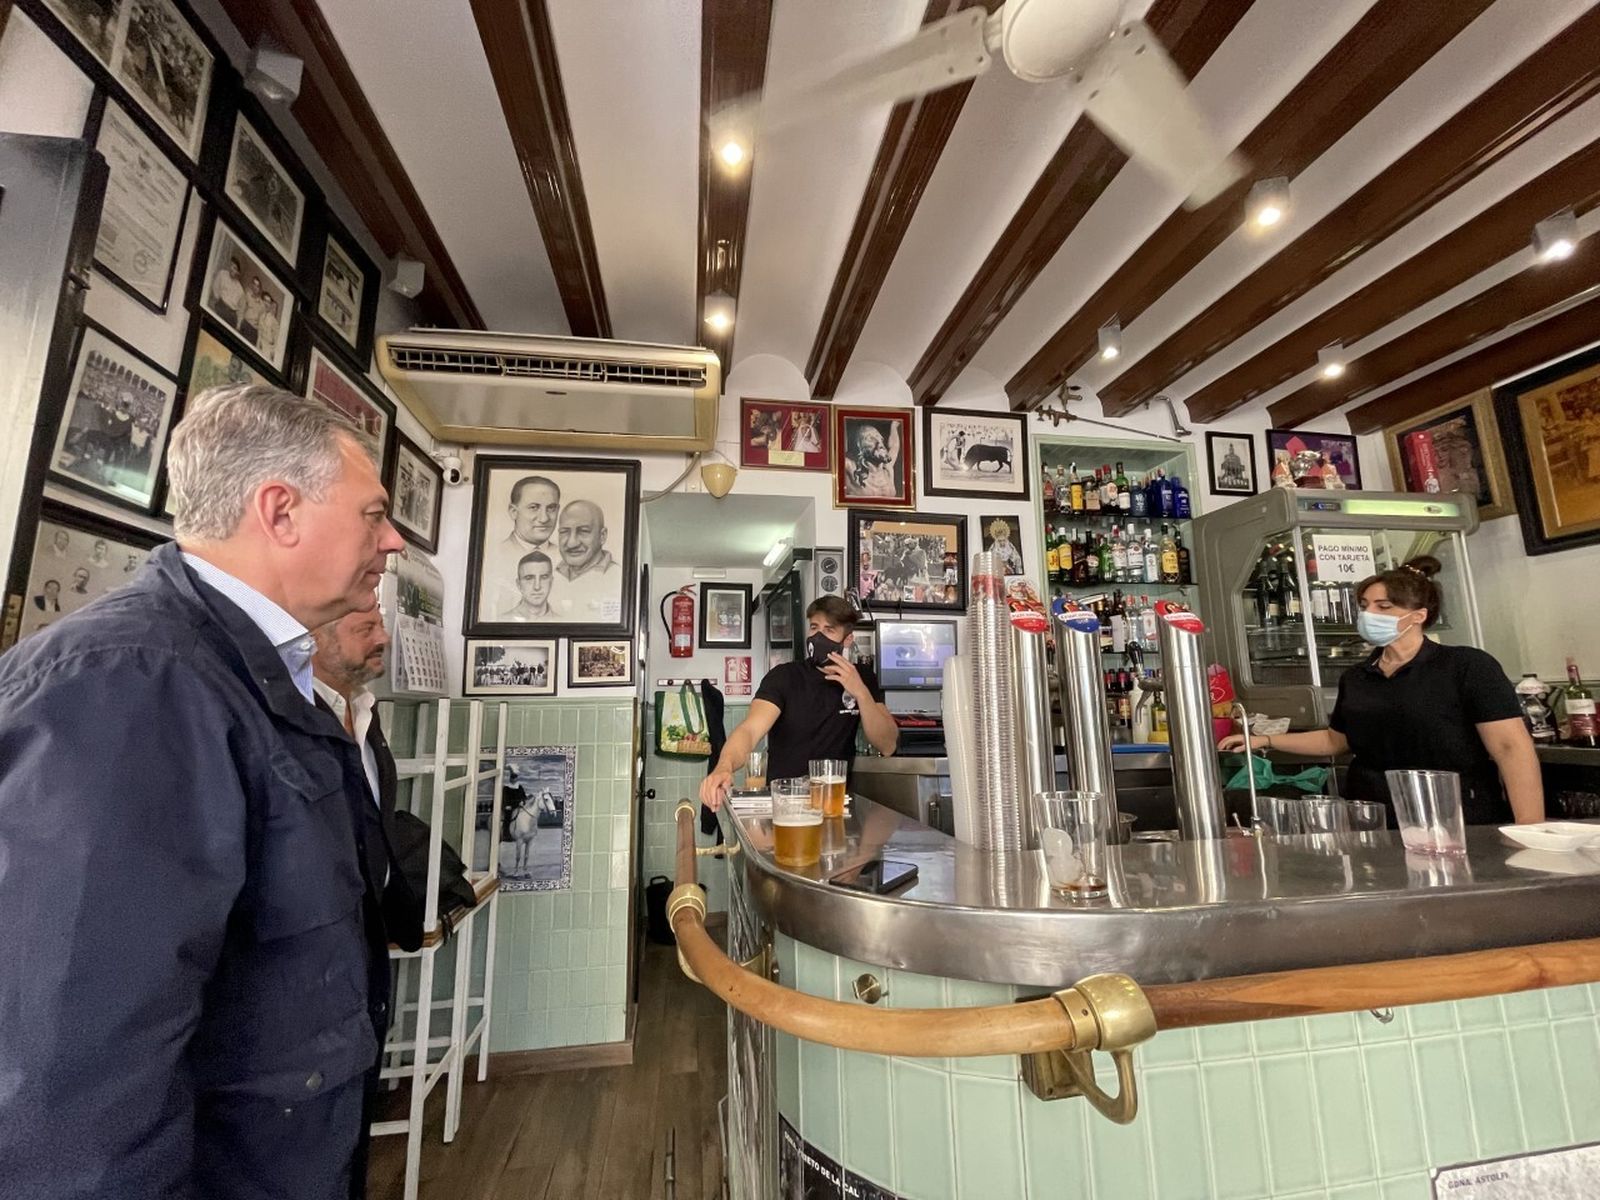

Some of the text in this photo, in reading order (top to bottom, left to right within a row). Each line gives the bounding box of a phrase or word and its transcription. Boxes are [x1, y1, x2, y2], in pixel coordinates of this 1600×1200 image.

[1338, 564, 1355, 573] 10€
[820, 1166, 831, 1179] DE
[831, 1173, 841, 1187] LA
[844, 1183, 860, 1198] CAL
